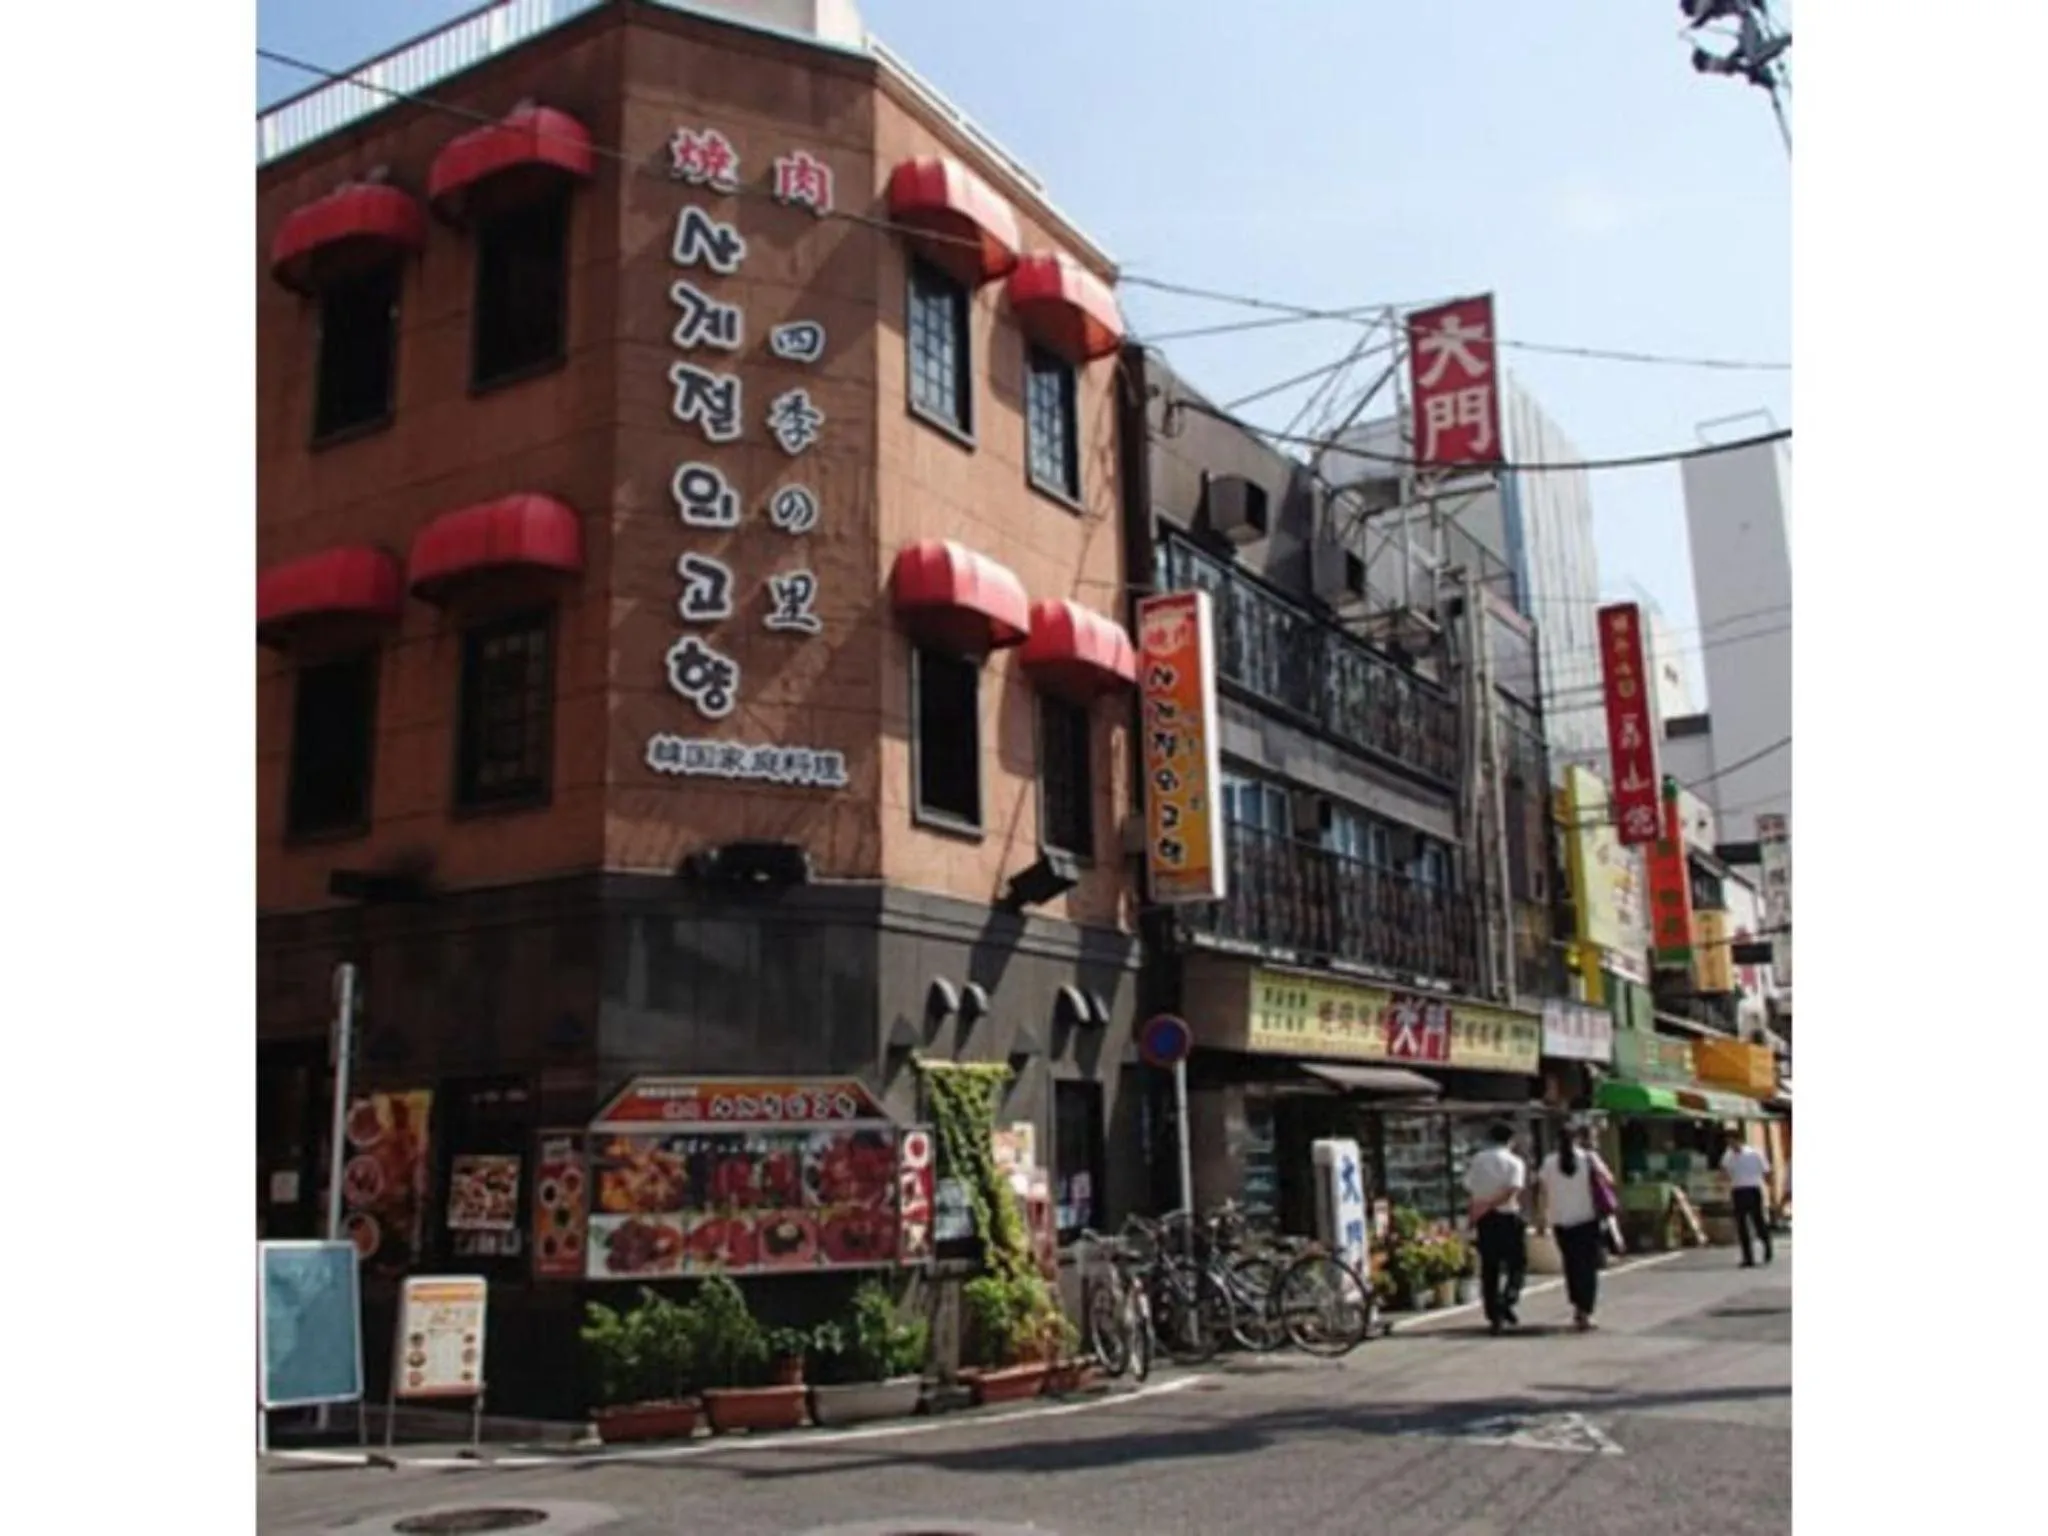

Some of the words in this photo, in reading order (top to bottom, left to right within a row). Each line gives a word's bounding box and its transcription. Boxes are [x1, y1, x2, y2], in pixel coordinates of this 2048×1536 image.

[764, 320, 825, 635] 四季の里
[1417, 314, 1492, 462] 大門
